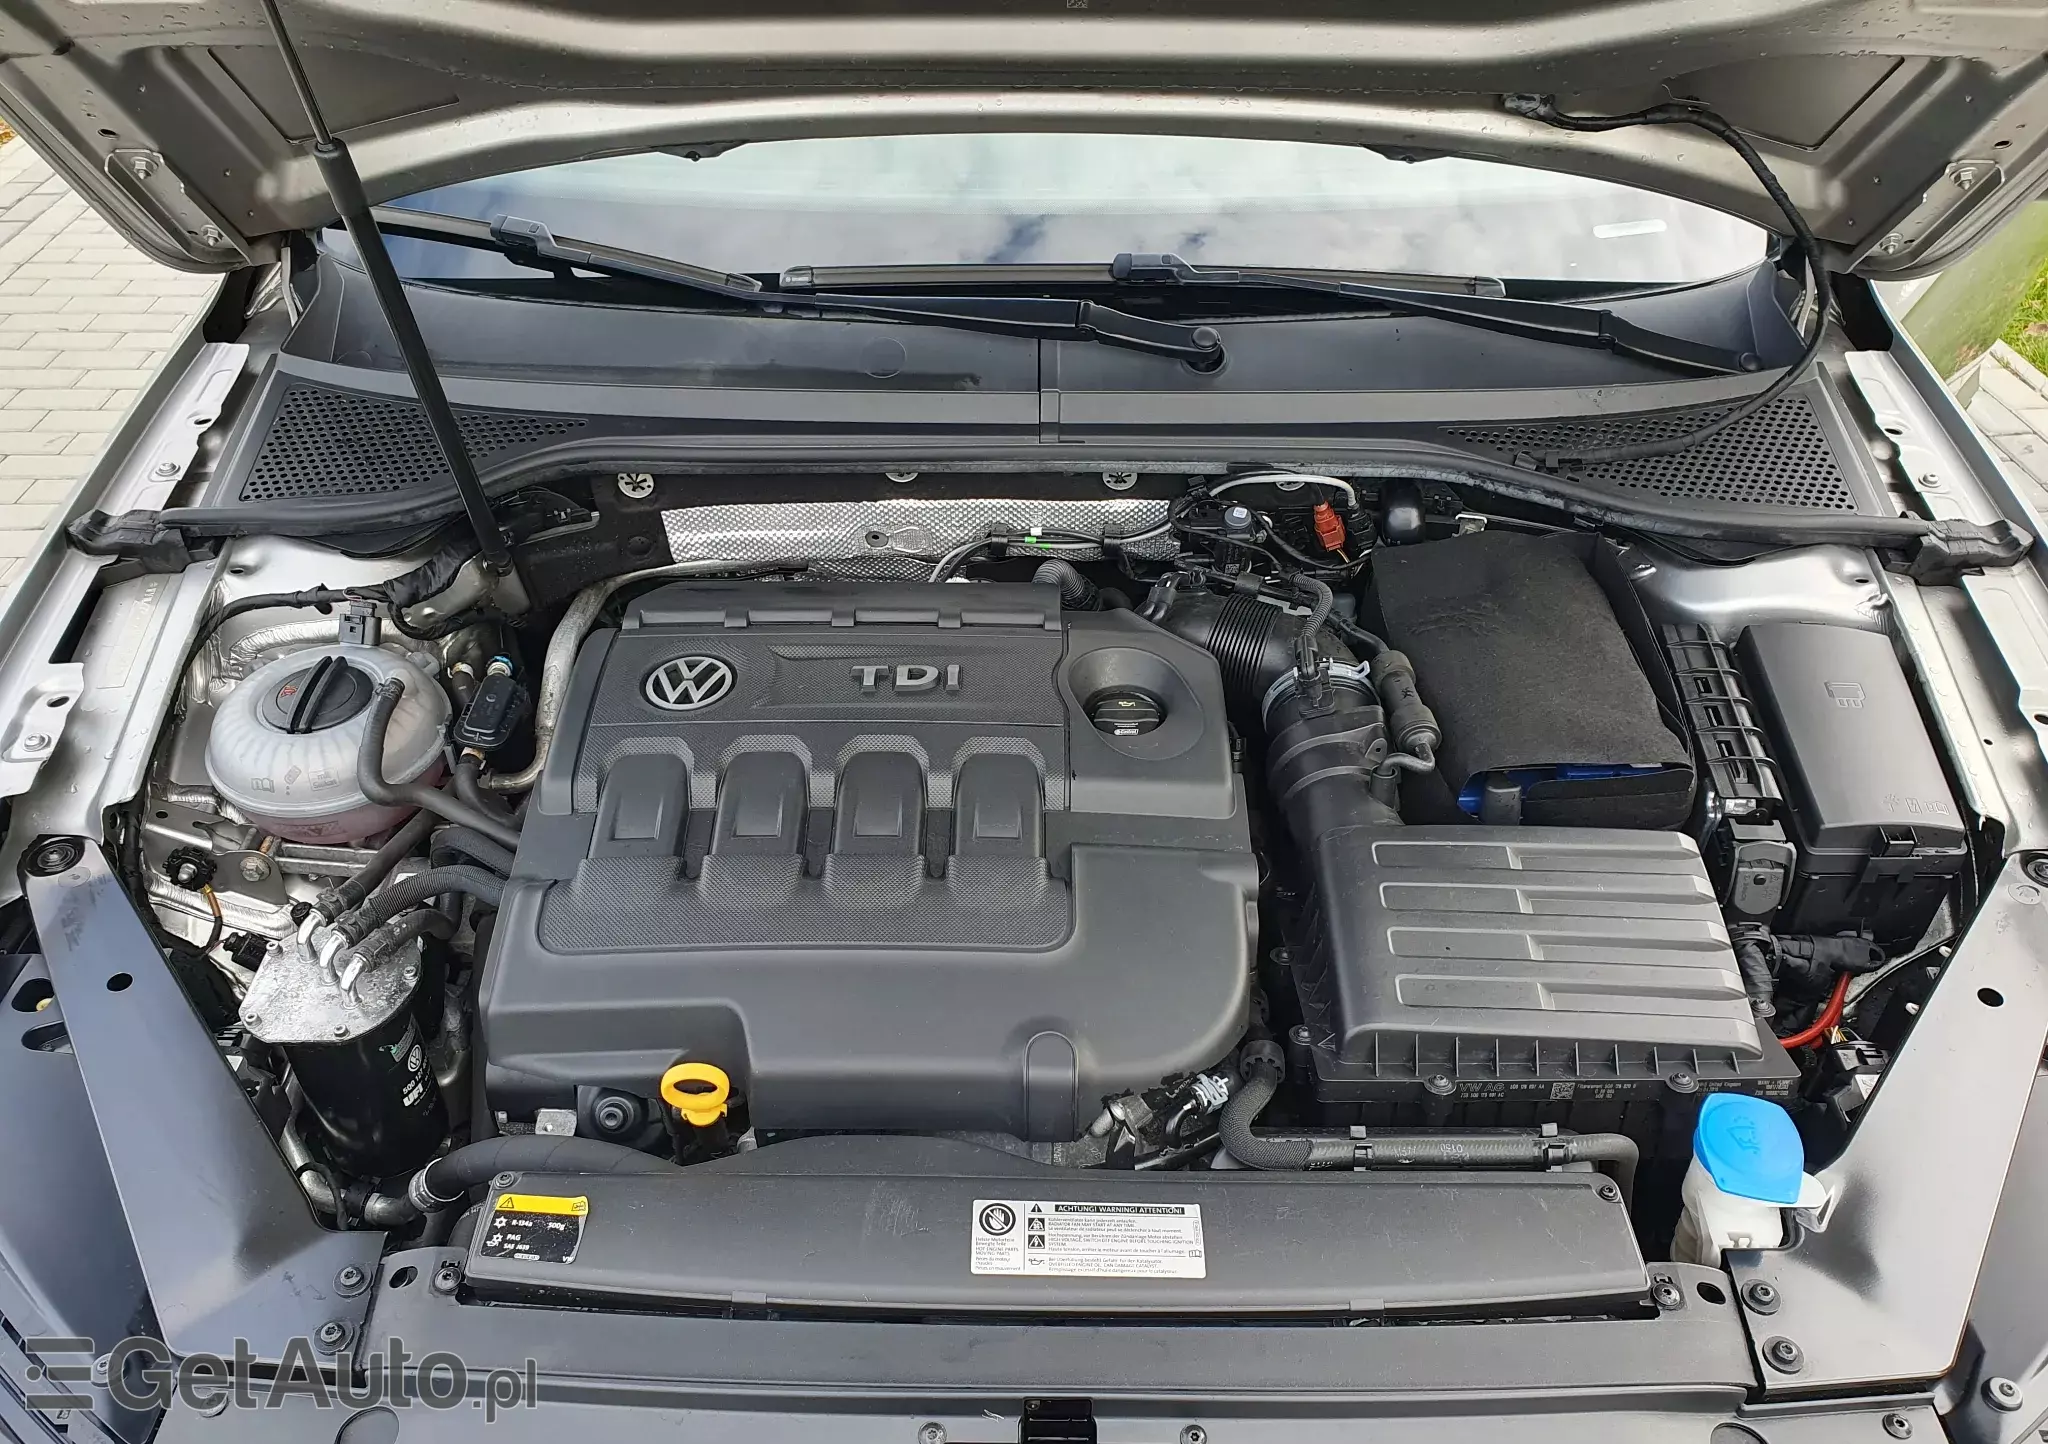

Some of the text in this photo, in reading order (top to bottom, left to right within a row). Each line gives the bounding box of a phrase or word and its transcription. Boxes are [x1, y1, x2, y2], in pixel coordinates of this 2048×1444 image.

[852, 664, 964, 692] TDI
[1459, 1082, 1505, 1092] VW AG
[402, 1082, 423, 1107] UFI
[1058, 1204, 1182, 1214] ACHTUNG! WARNING! ATTENTION!
[511, 1219, 566, 1231] R-134a 500g
